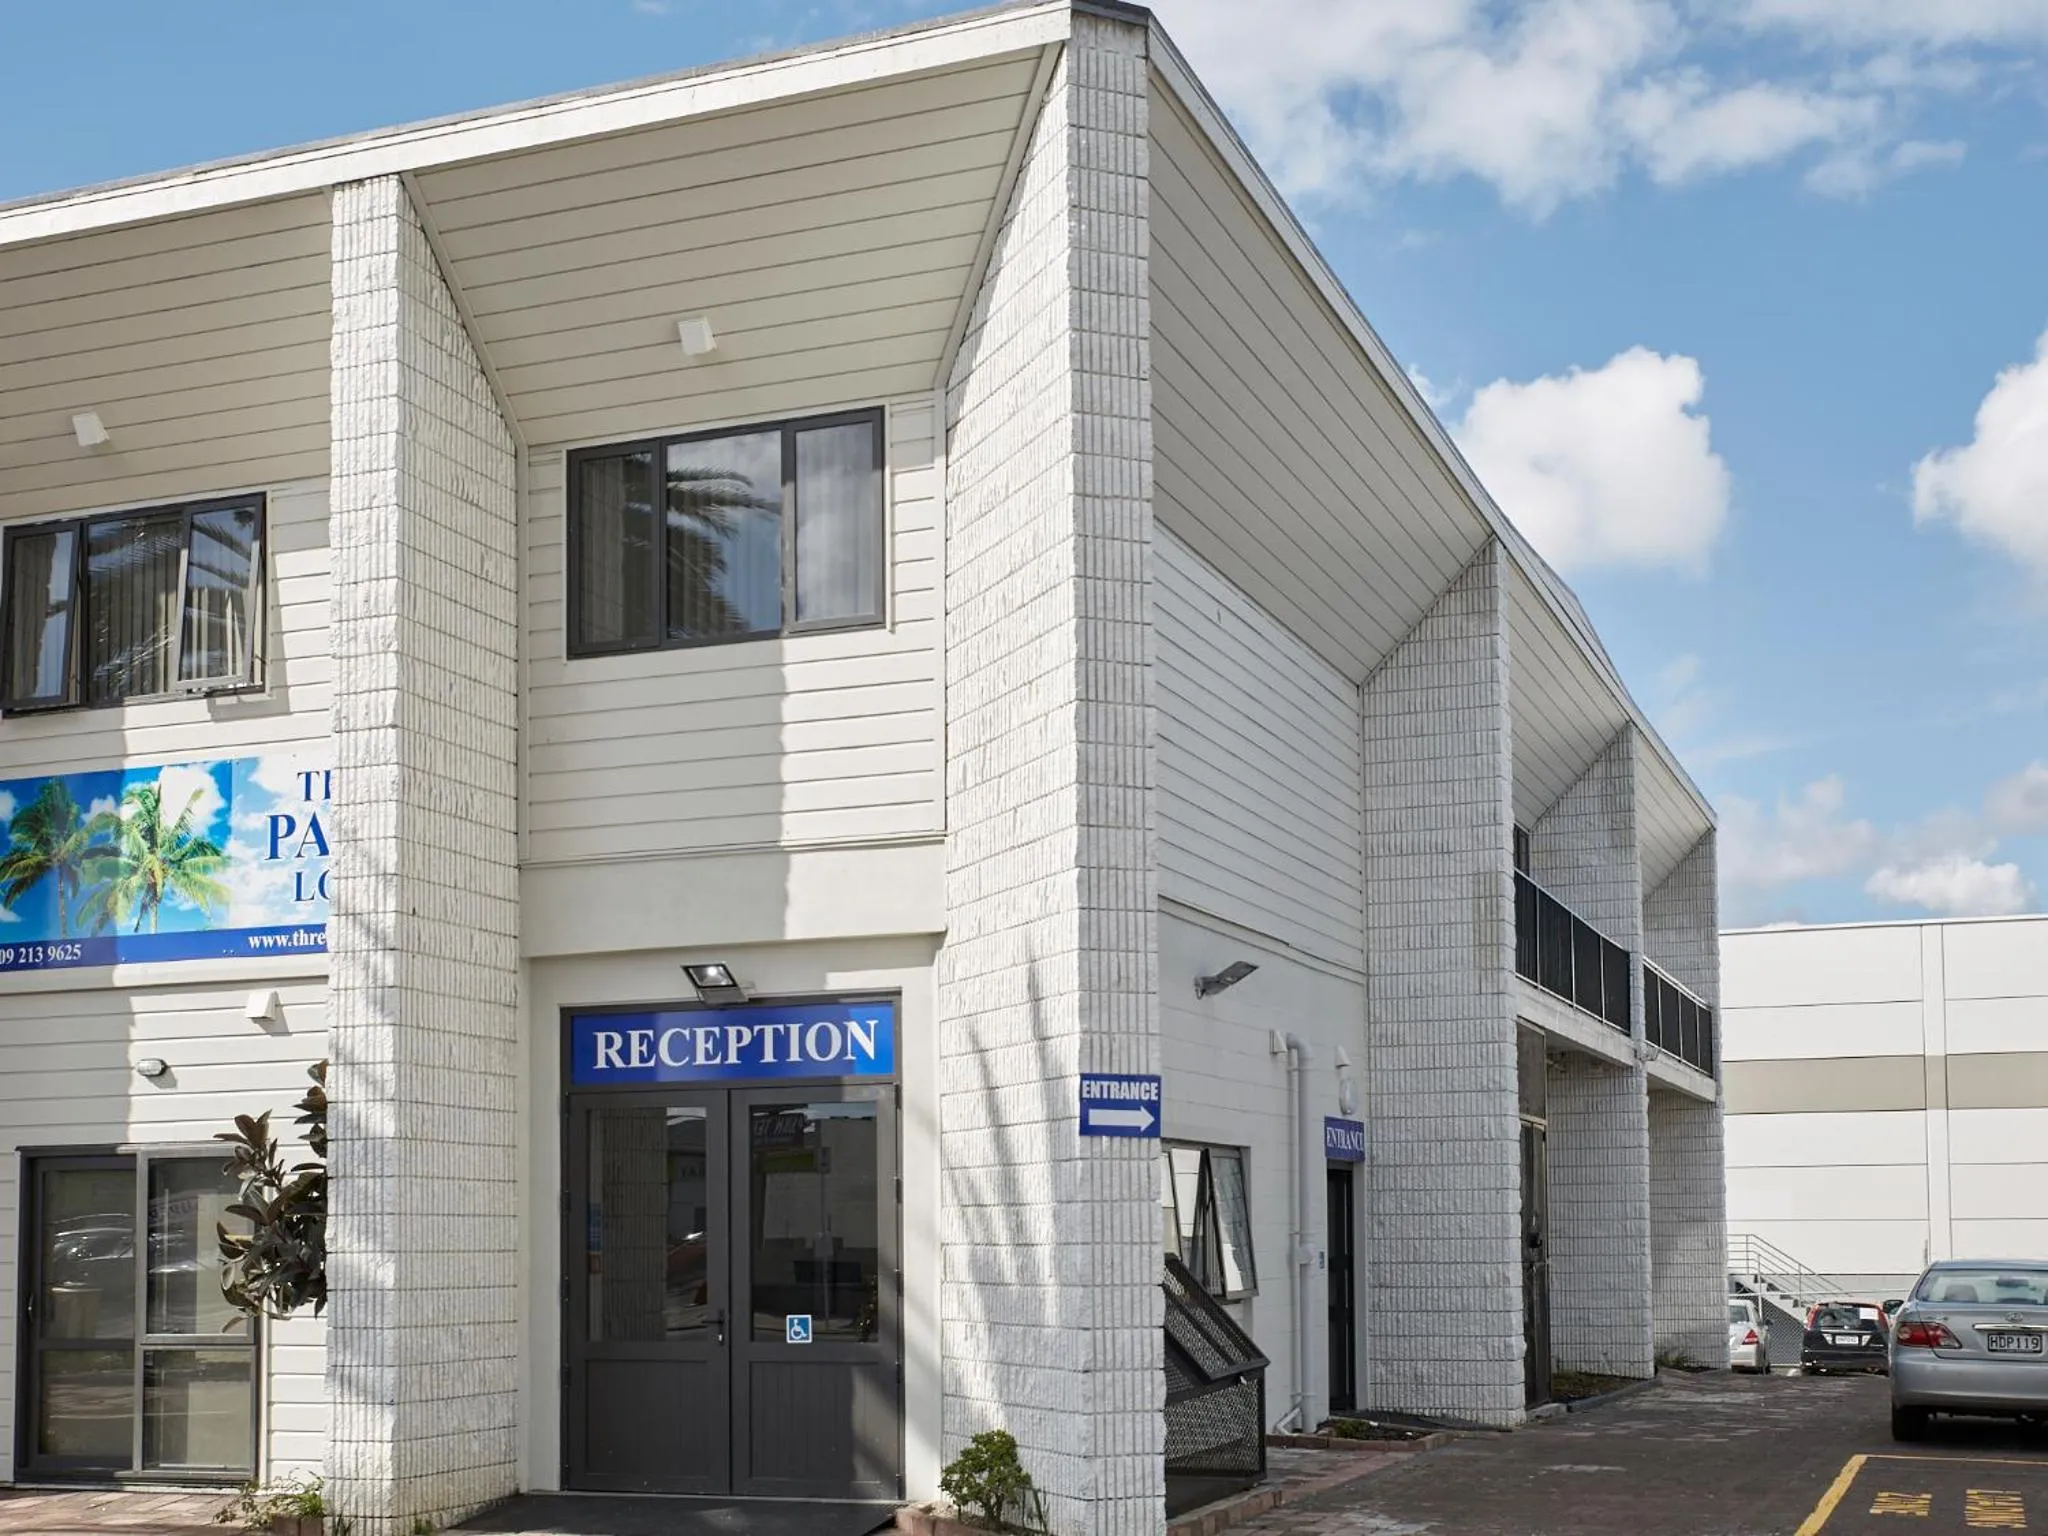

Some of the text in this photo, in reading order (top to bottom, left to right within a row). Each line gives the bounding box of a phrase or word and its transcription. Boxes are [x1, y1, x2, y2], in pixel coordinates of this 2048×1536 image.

[18, 946, 43, 964] 213
[47, 943, 82, 962] 9625
[592, 1019, 878, 1069] RECEPTION
[1081, 1080, 1159, 1100] ENTRANCE
[1990, 1336, 2039, 1350] HDP119
